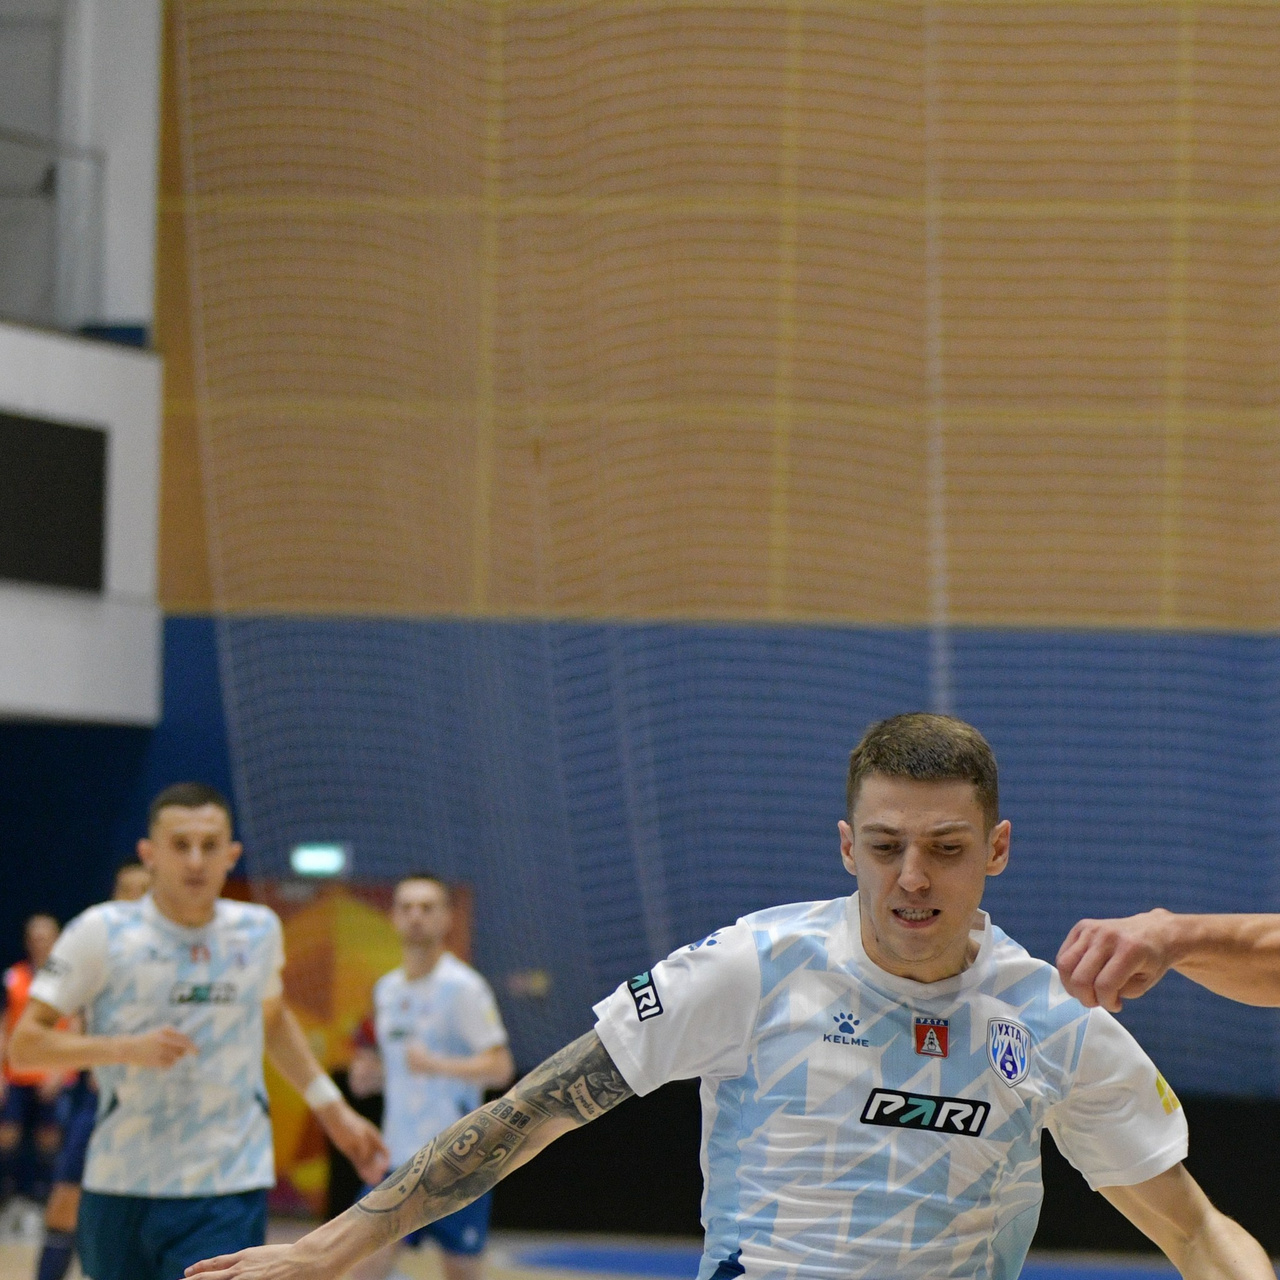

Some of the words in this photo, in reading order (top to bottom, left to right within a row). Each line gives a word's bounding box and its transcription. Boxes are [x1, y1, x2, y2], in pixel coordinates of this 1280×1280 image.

[823, 1033, 869, 1048] KELME
[998, 1023, 1022, 1044] УХТА
[865, 1092, 986, 1133] PARI
